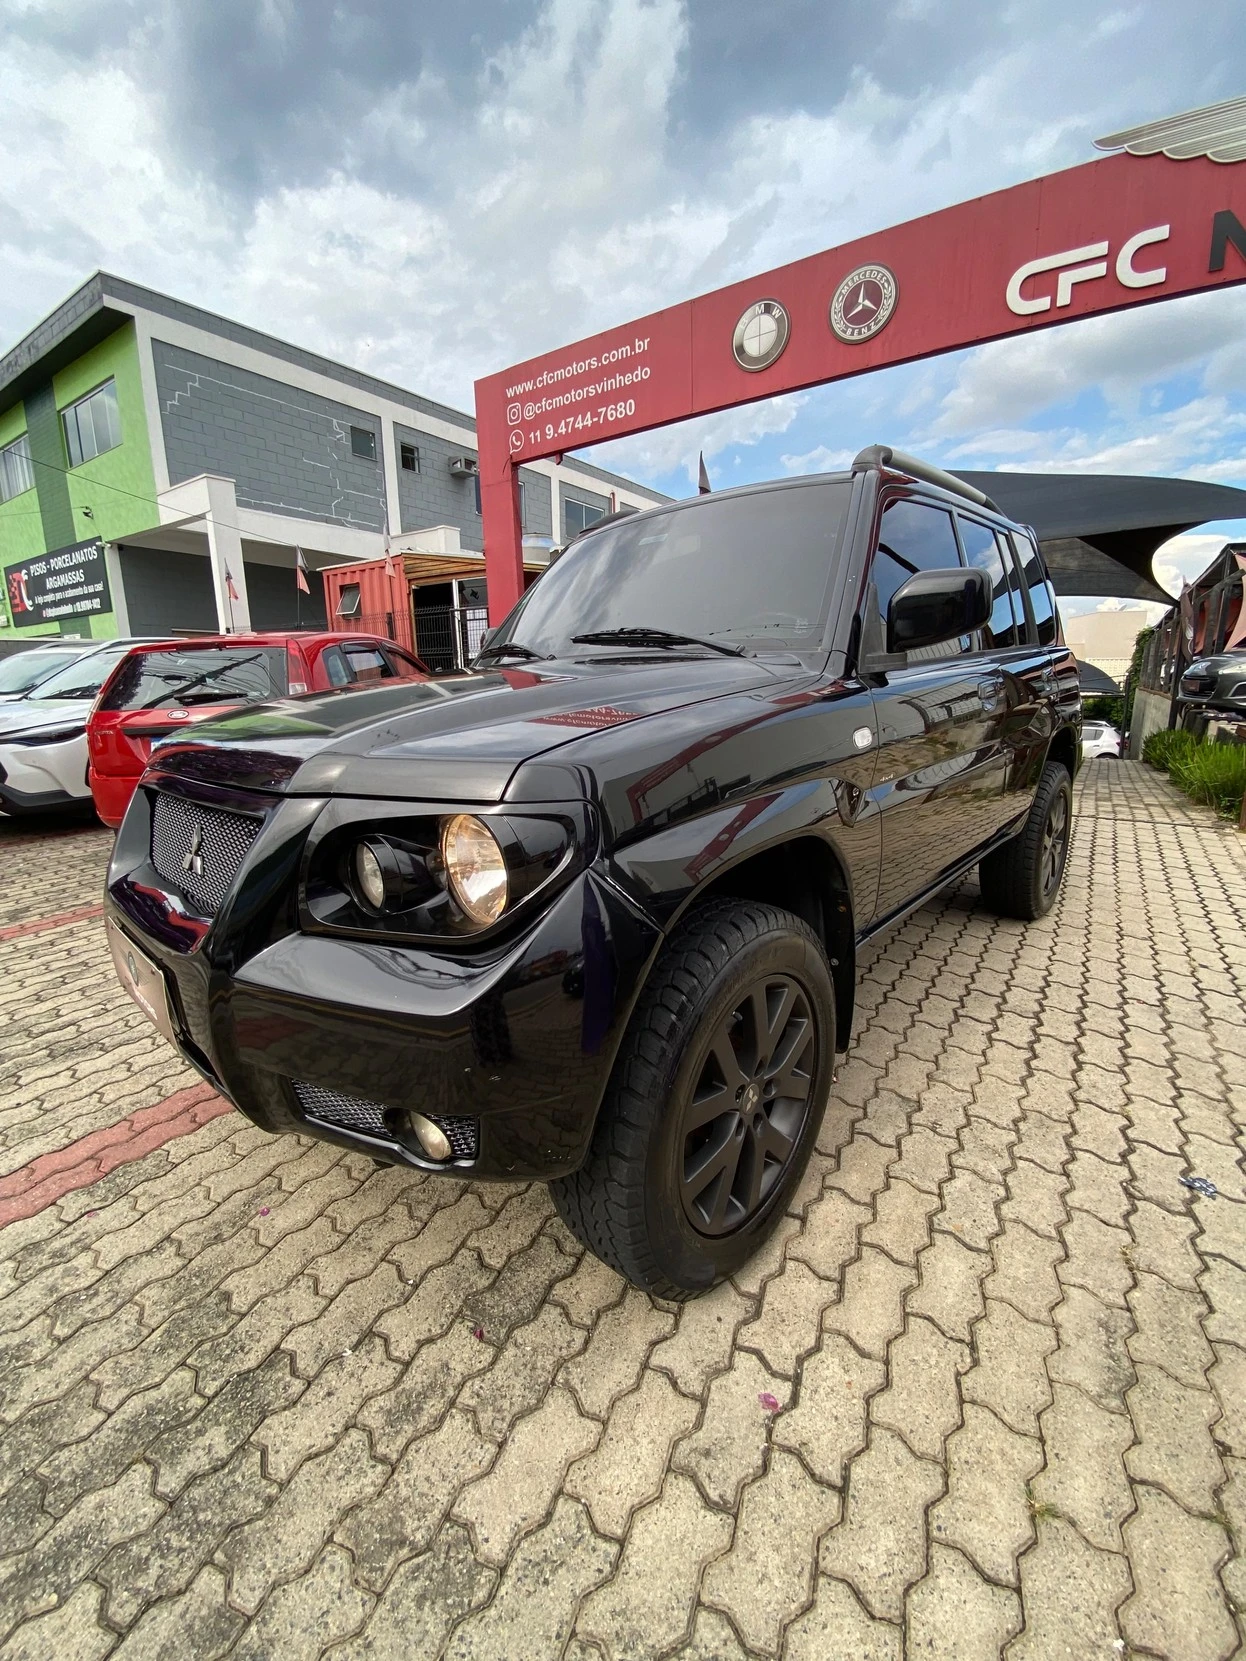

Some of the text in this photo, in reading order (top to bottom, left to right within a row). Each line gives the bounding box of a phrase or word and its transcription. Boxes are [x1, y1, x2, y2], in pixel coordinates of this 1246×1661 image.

[841, 270, 887, 296] MERCEDES
[1006, 224, 1170, 315] CFC
[738, 303, 782, 329] BMW
[846, 321, 877, 336] BENZ
[506, 337, 651, 398] www.cfcmotors.com.br
[523, 365, 651, 420] @cfcmotorsvinhedo
[528, 398, 636, 445] 11 9.4744-7680
[30, 561, 48, 577] PISOS
[50, 545, 98, 571] PORCELANATOS
[46, 569, 85, 590] ARGAMASSAS
